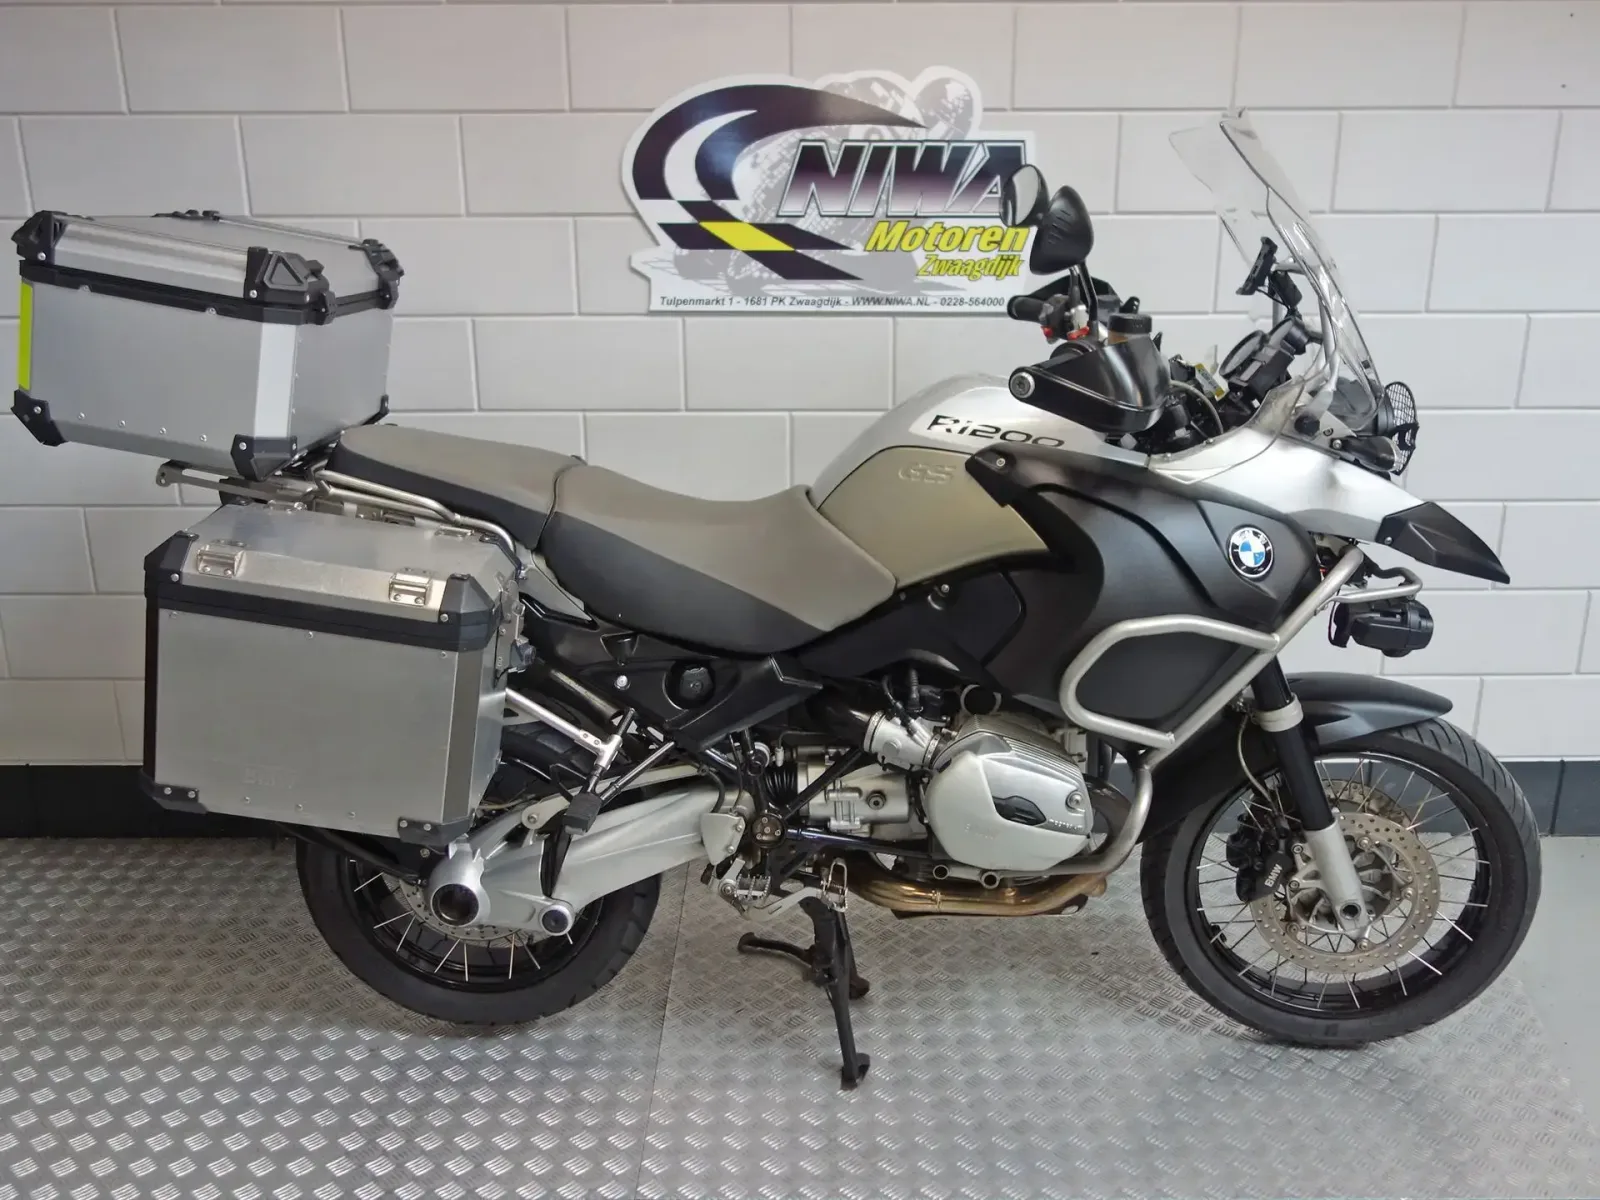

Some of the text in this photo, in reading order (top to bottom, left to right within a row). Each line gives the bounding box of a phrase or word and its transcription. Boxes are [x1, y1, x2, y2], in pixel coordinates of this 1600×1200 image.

[776, 139, 1027, 218] NIWA
[864, 221, 1031, 252] Motoren
[916, 254, 1024, 281] Zwaagdijk
[660, 296, 725, 307] Tulpenmarkt
[729, 296, 734, 306] 1
[744, 296, 767, 306] 1681
[770, 296, 786, 306] PK
[789, 296, 842, 308] Zwaagdijk
[852, 296, 930, 307] WWW.NIWA.NL
[940, 296, 1005, 307] 0228-564000
[1264, 863, 1283, 888] BMW
